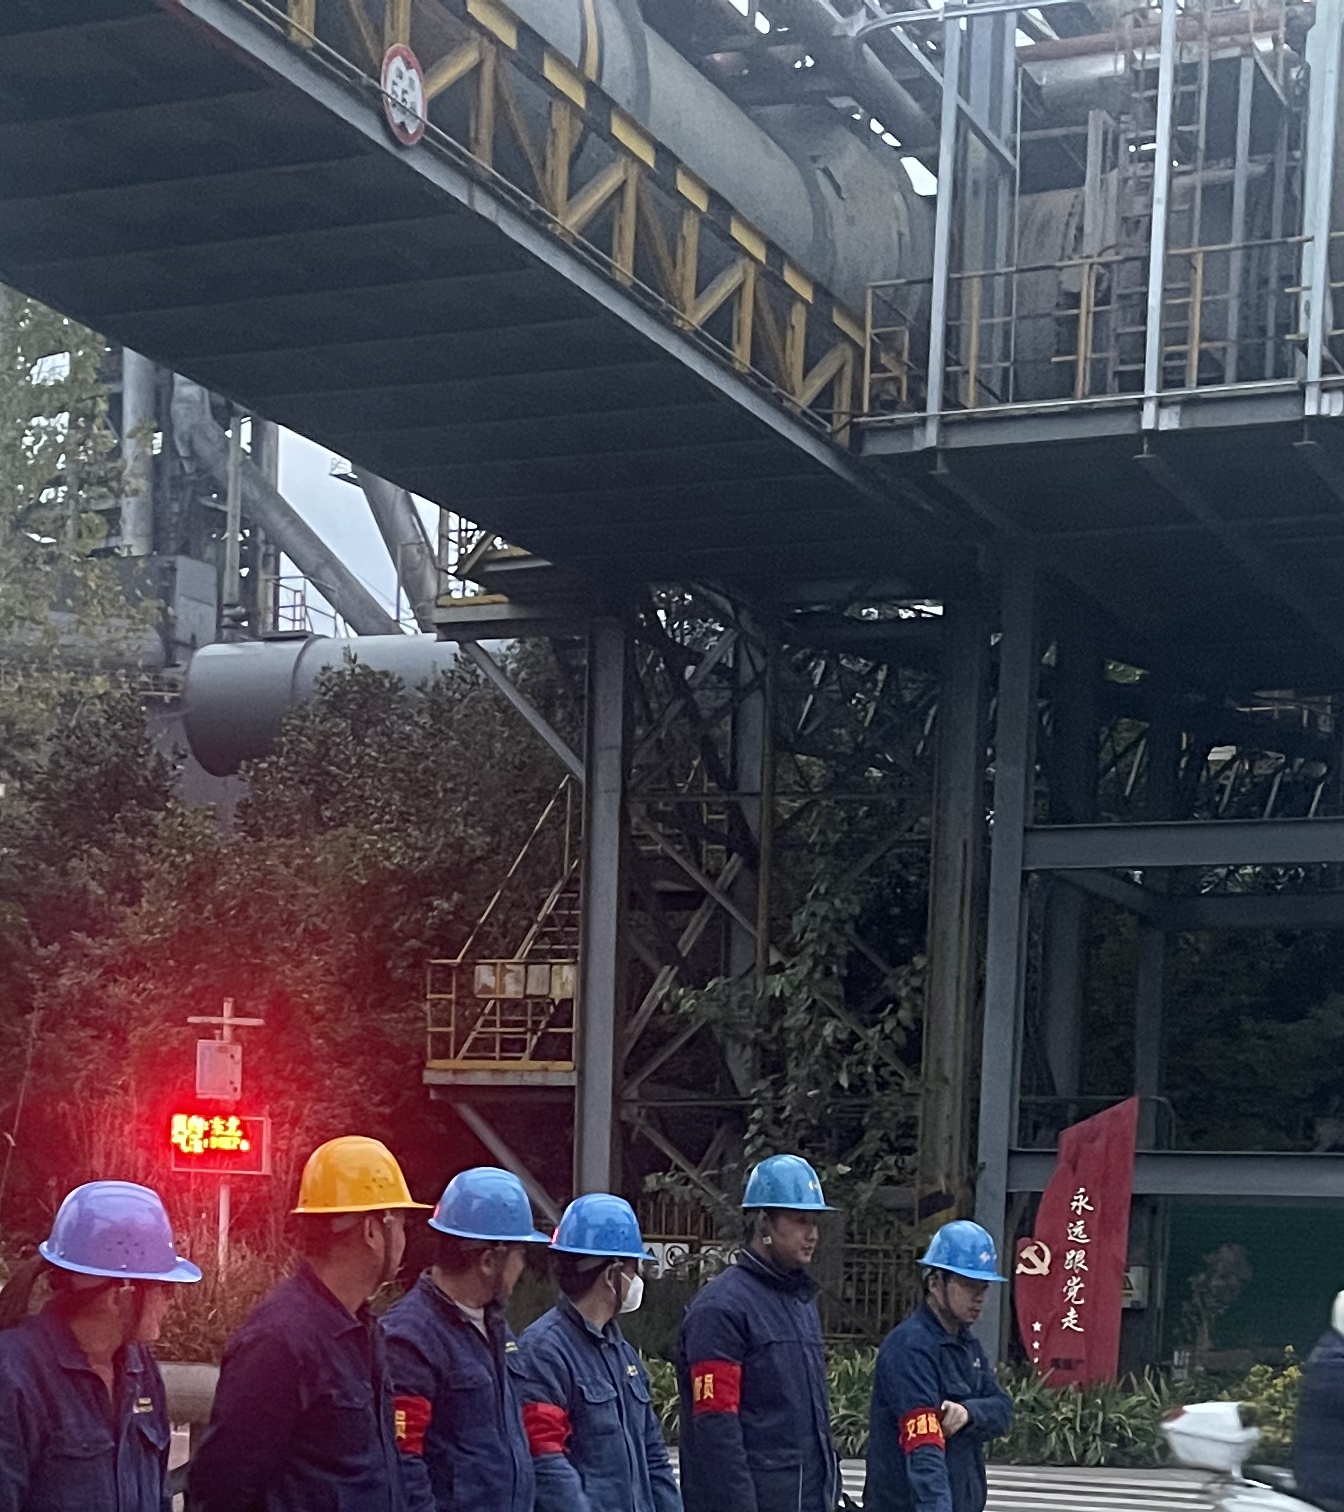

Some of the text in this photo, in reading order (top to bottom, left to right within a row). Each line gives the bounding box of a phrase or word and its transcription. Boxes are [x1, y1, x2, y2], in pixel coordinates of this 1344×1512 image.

[1060, 1187, 1095, 1333] 永远跟党走
